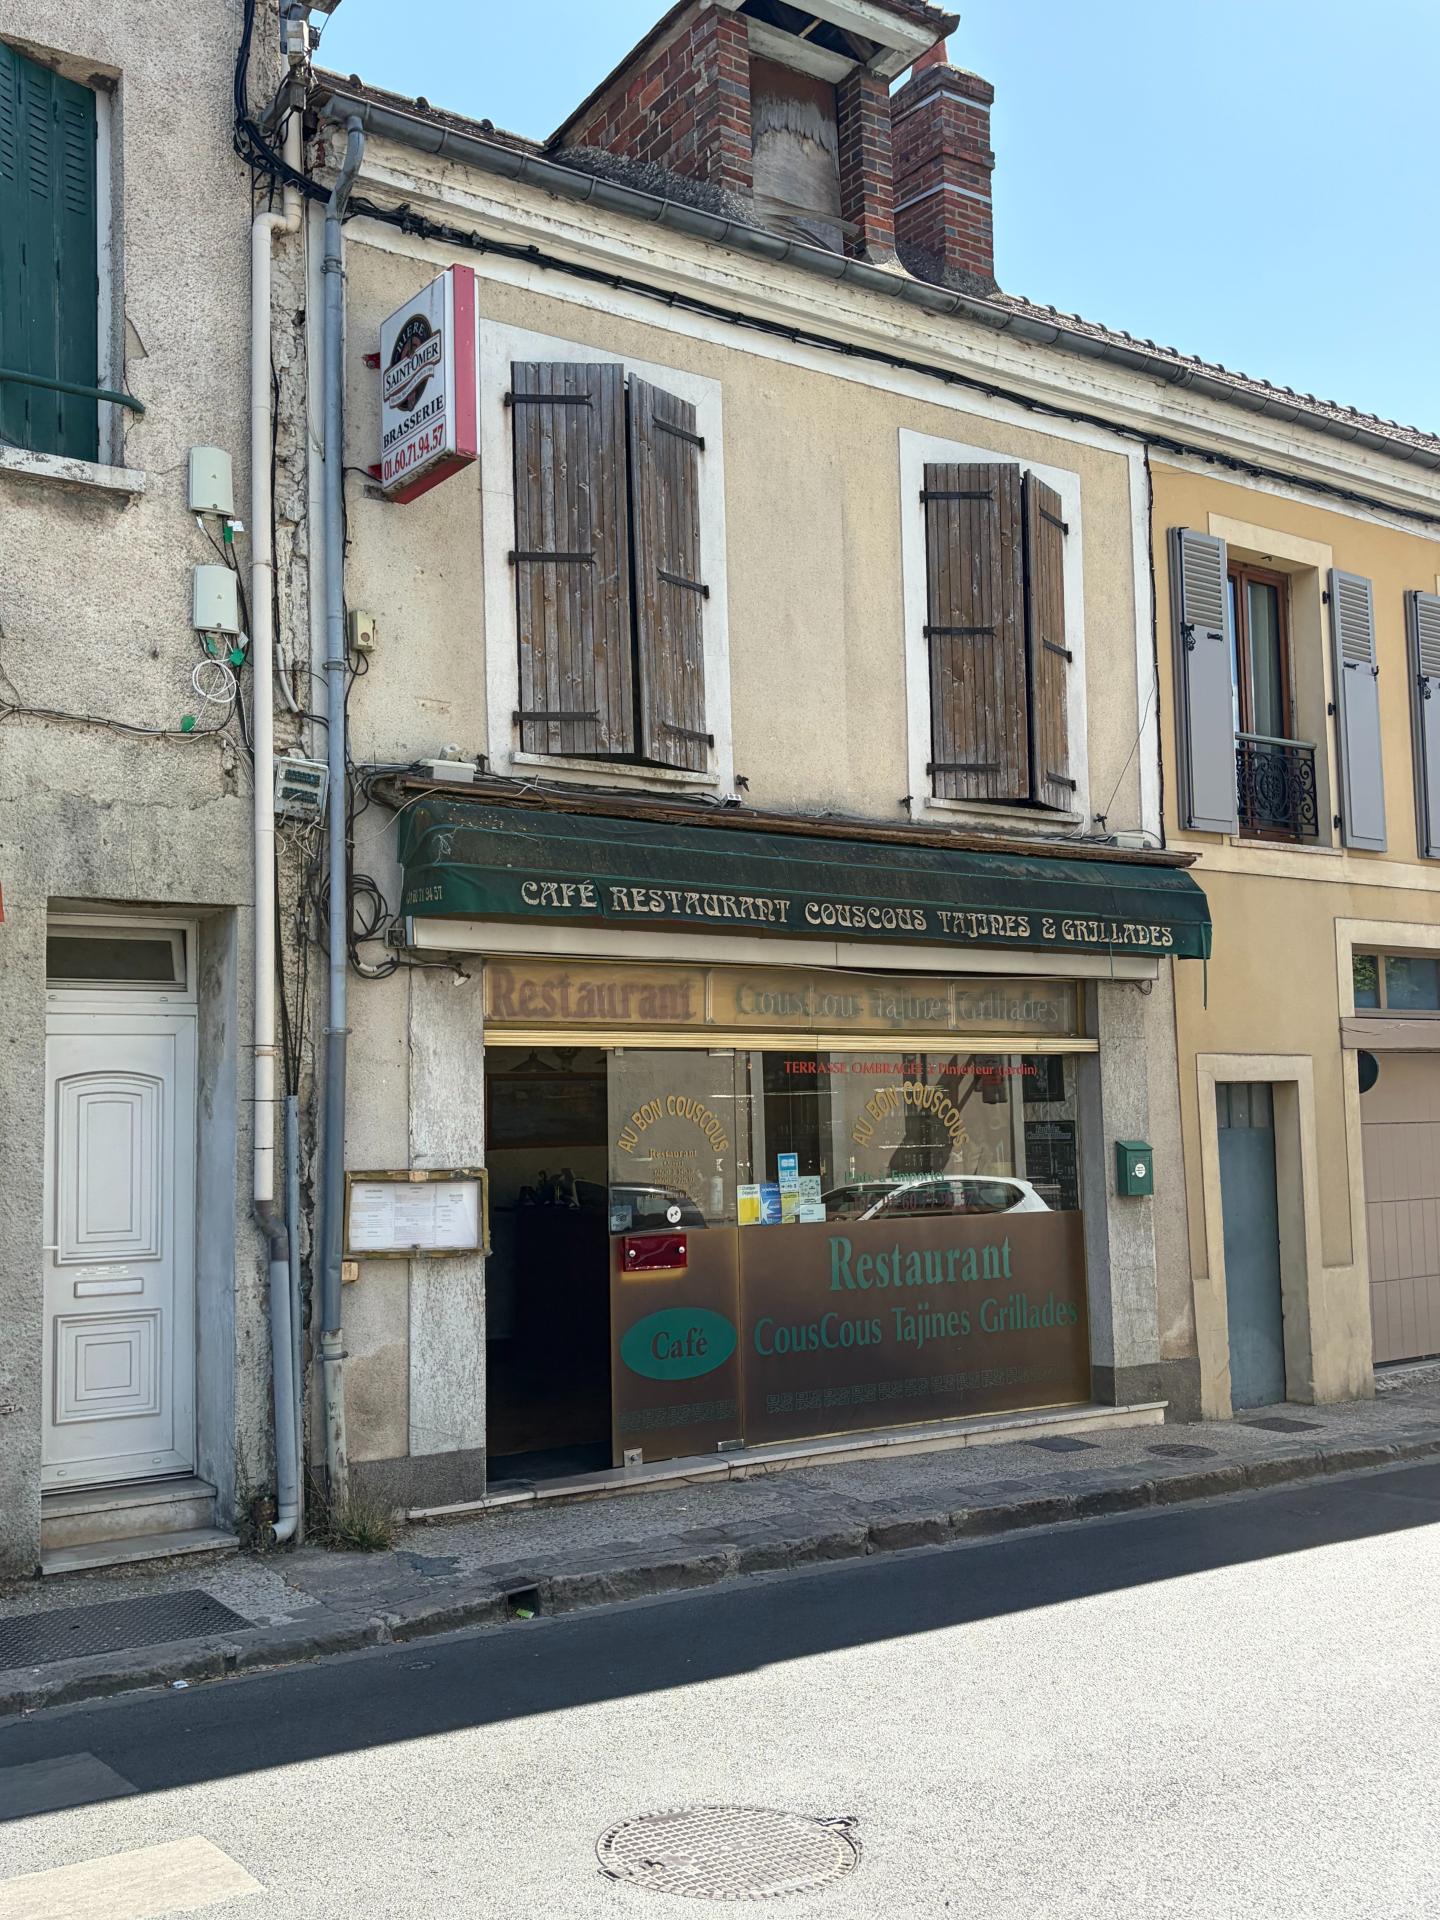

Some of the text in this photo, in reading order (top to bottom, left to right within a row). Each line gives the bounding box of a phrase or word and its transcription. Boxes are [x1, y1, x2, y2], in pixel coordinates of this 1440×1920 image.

[383, 395, 443, 450] BRASSERIE
[383, 423, 444, 481] 01.60.71.94.57
[521, 880, 1174, 946] CAFÉ RESTAURANT COUSCOUS TAJINES & GRILLADES
[490, 966, 697, 1020] Restaurant
[784, 1061, 849, 1074] TERRASSE
[617, 1095, 730, 1153] AU BON COUSCOUS
[852, 1081, 970, 1148] AU BON COUSCOUS
[828, 1235, 1012, 1291] Restaurant
[651, 1327, 708, 1361] Café
[753, 1291, 1078, 1356] CousCous Tajines Grillades
